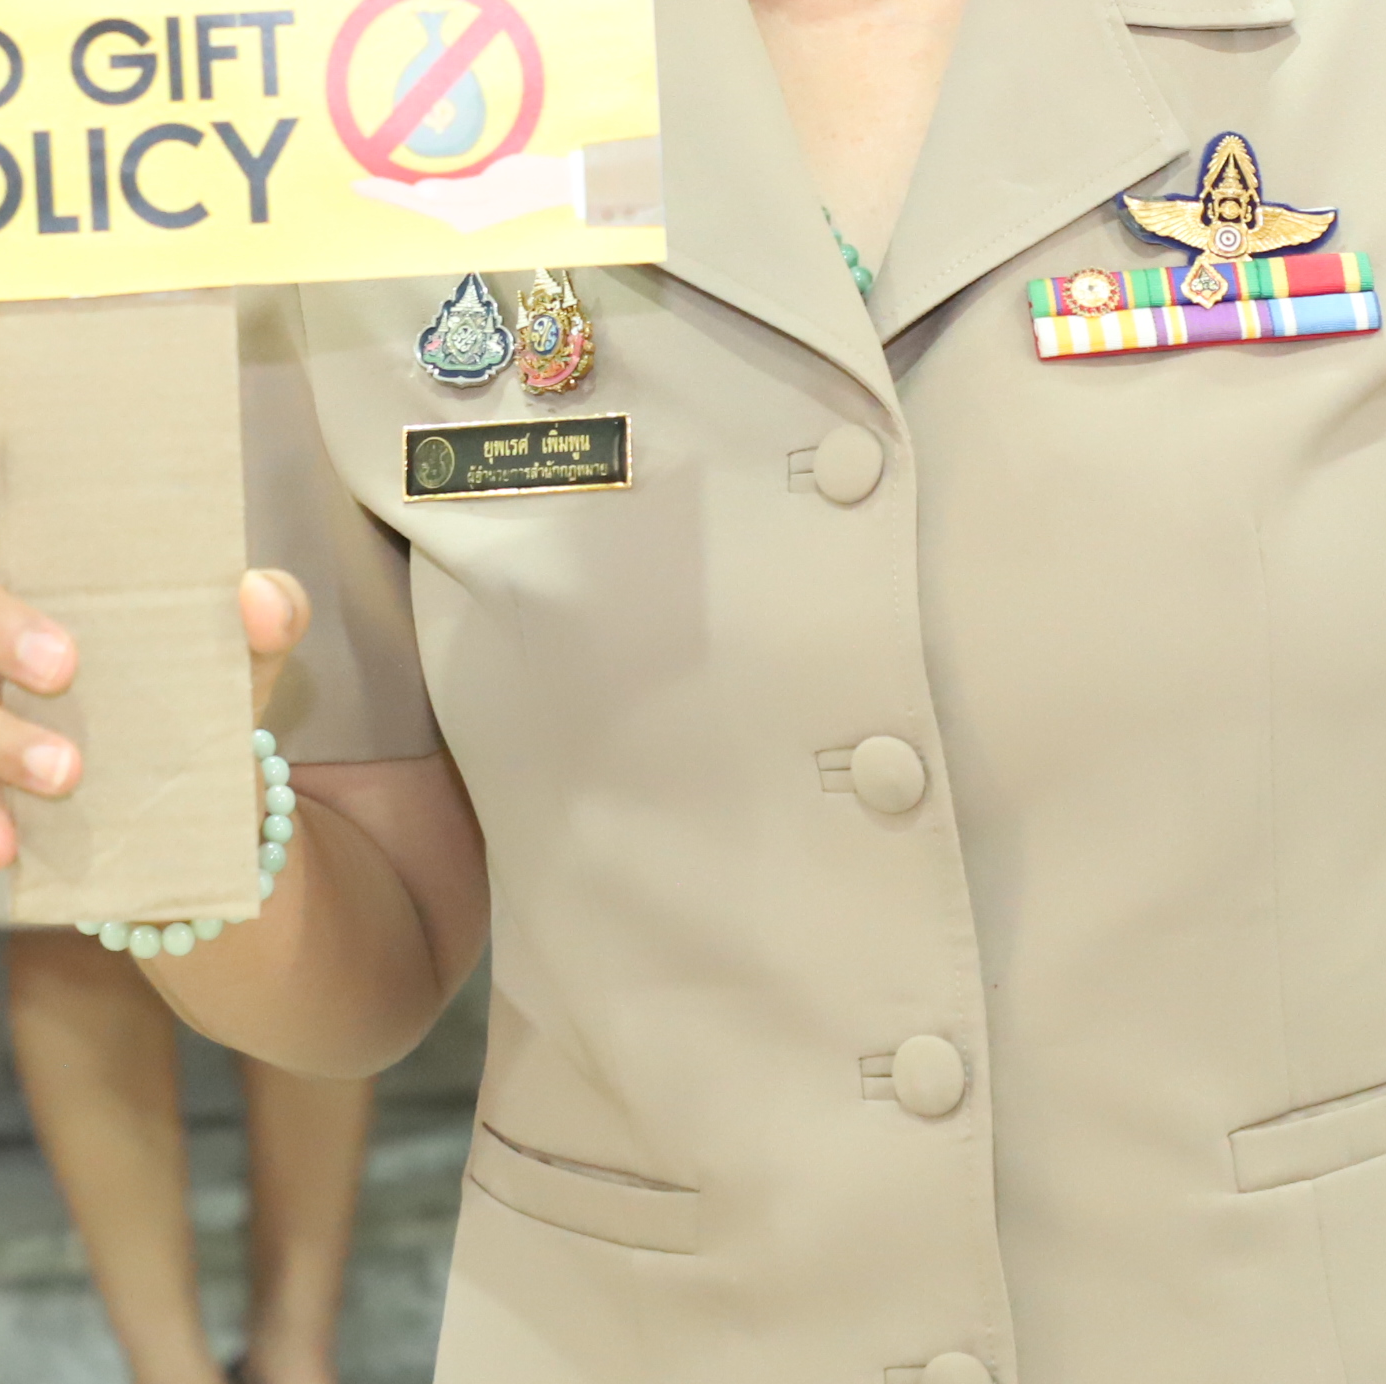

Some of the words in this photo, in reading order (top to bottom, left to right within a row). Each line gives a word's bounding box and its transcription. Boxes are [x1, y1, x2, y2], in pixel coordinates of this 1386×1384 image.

[70, 10, 296, 105] GIFT
[484, 433, 530, 465] ยุพเรศ
[542, 423, 591, 460] เพิ่มพูน
